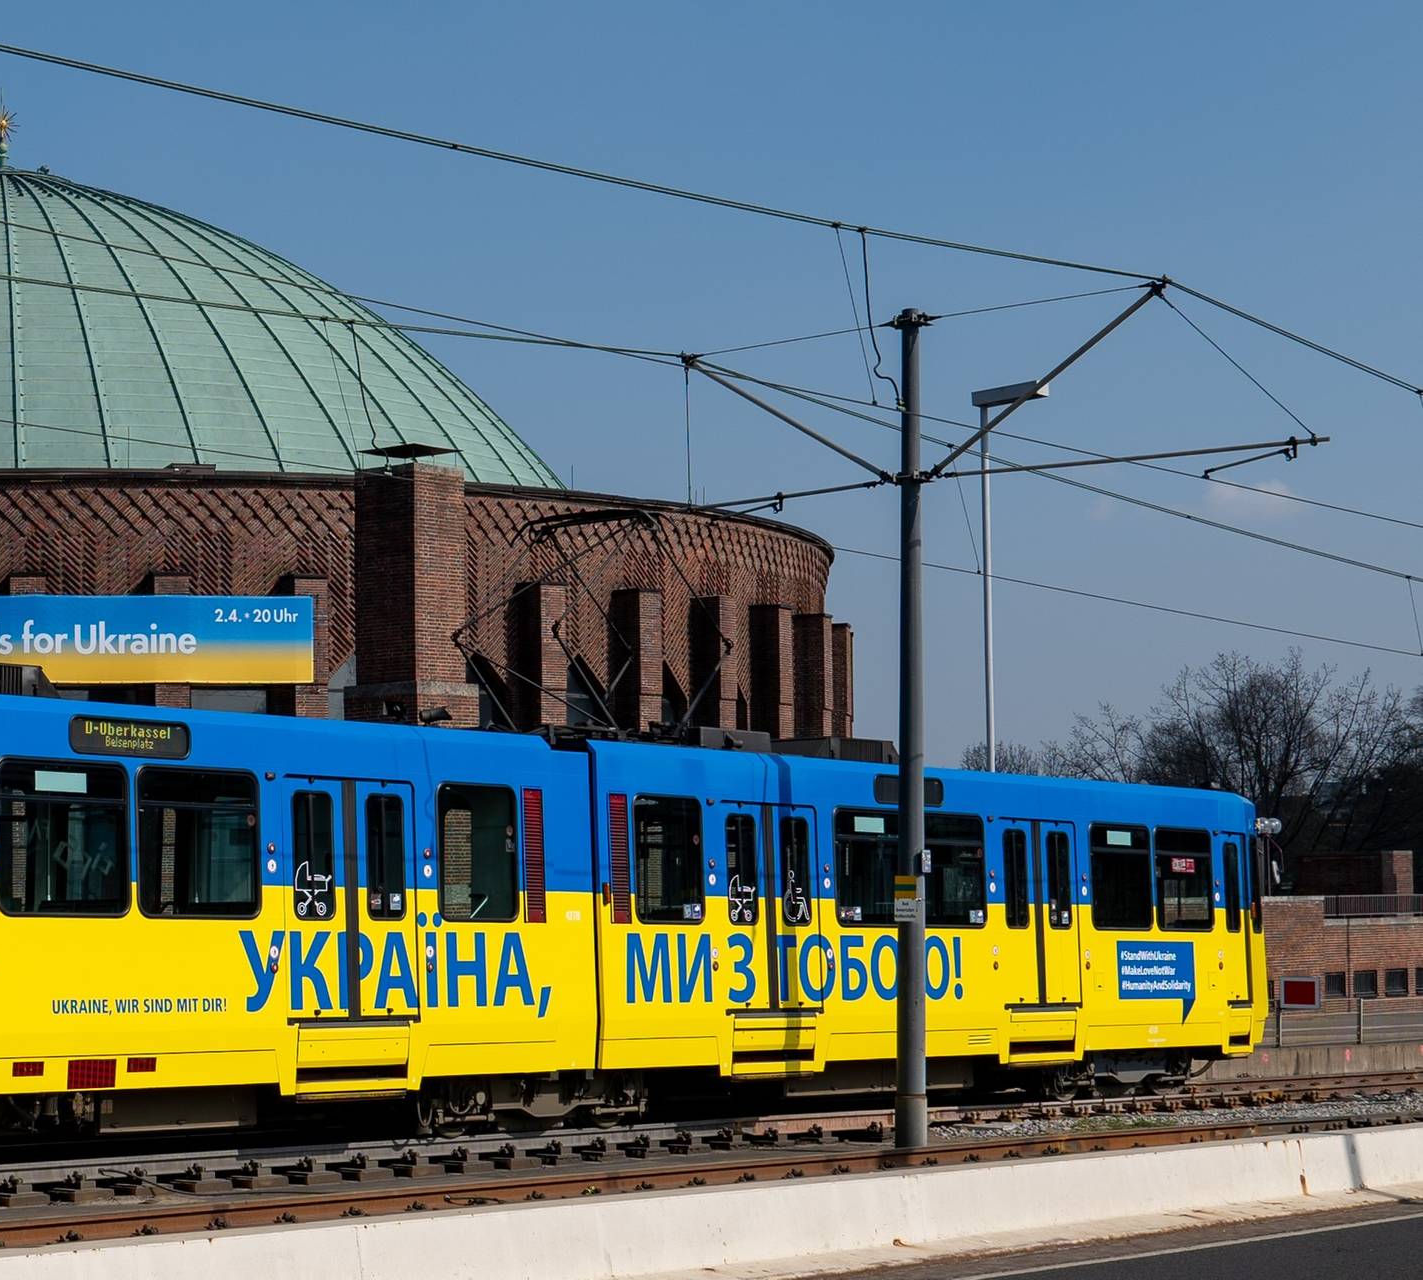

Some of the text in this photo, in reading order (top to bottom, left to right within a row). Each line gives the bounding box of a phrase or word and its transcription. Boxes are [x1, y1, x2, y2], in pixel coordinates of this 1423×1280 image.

[214, 608, 298, 623] 2.4. 20 Uhr
[21, 619, 68, 655] for
[74, 621, 197, 655] Ukraine
[105, 735, 154, 750] Belsenplatz
[1120, 950, 1177, 961] #StandWithUkraine
[238, 911, 552, 1018] УКРАЇНА,
[625, 932, 714, 1004] МИ
[727, 932, 757, 1004] З
[1121, 965, 1176, 976] #MakeLoveNotWar
[1121, 980, 1191, 993] #HumanityAndSolidarity
[52, 997, 227, 1016] UKRAINE, WIR SIND MIT DIR!
